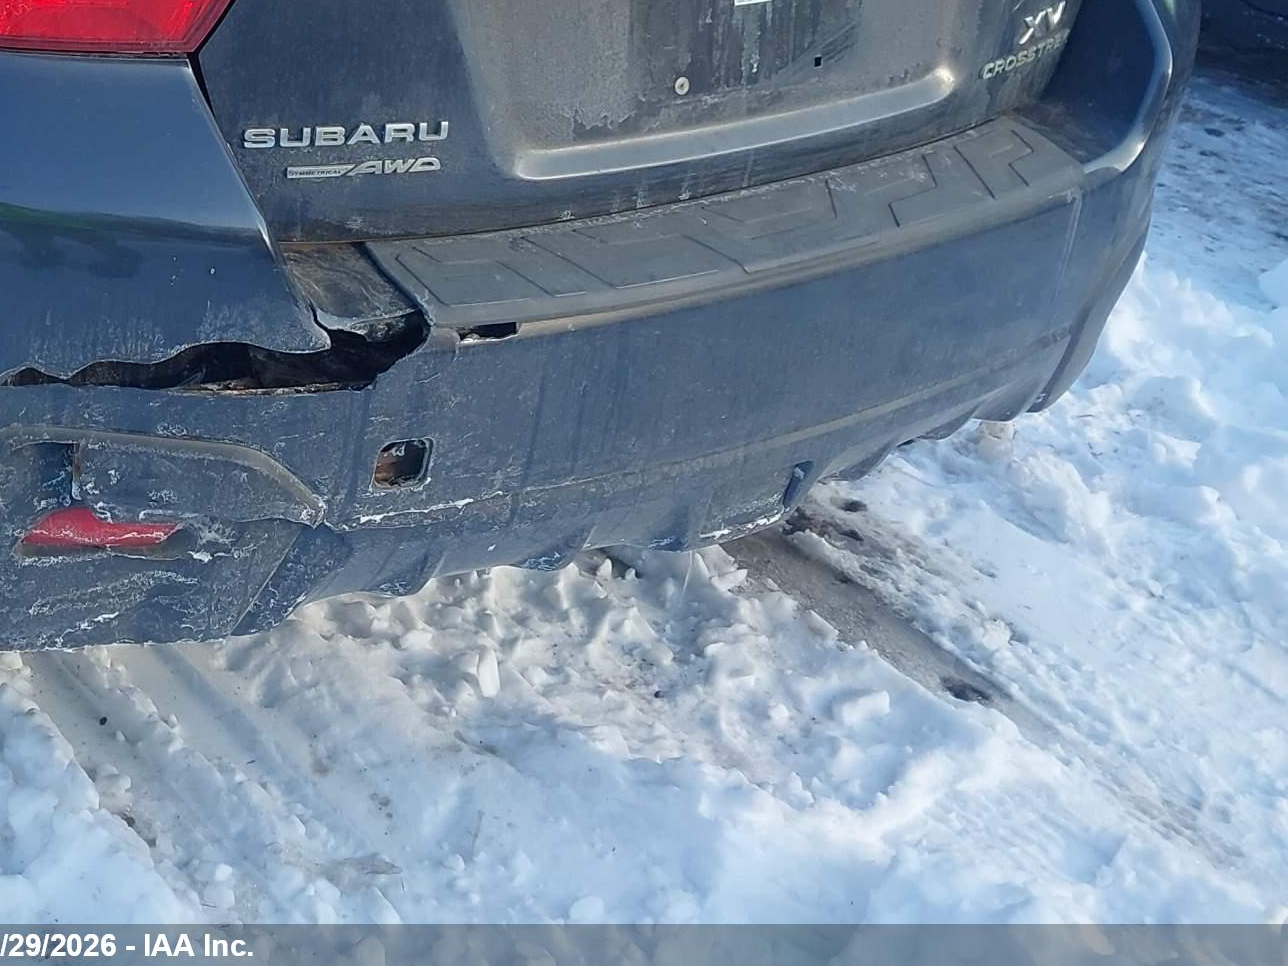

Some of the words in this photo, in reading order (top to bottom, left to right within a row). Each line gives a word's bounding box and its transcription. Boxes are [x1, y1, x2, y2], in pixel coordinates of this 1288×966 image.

[1018, 0, 1066, 45] XV
[244, 121, 449, 148] SUBARU
[344, 156, 441, 176] AWD
